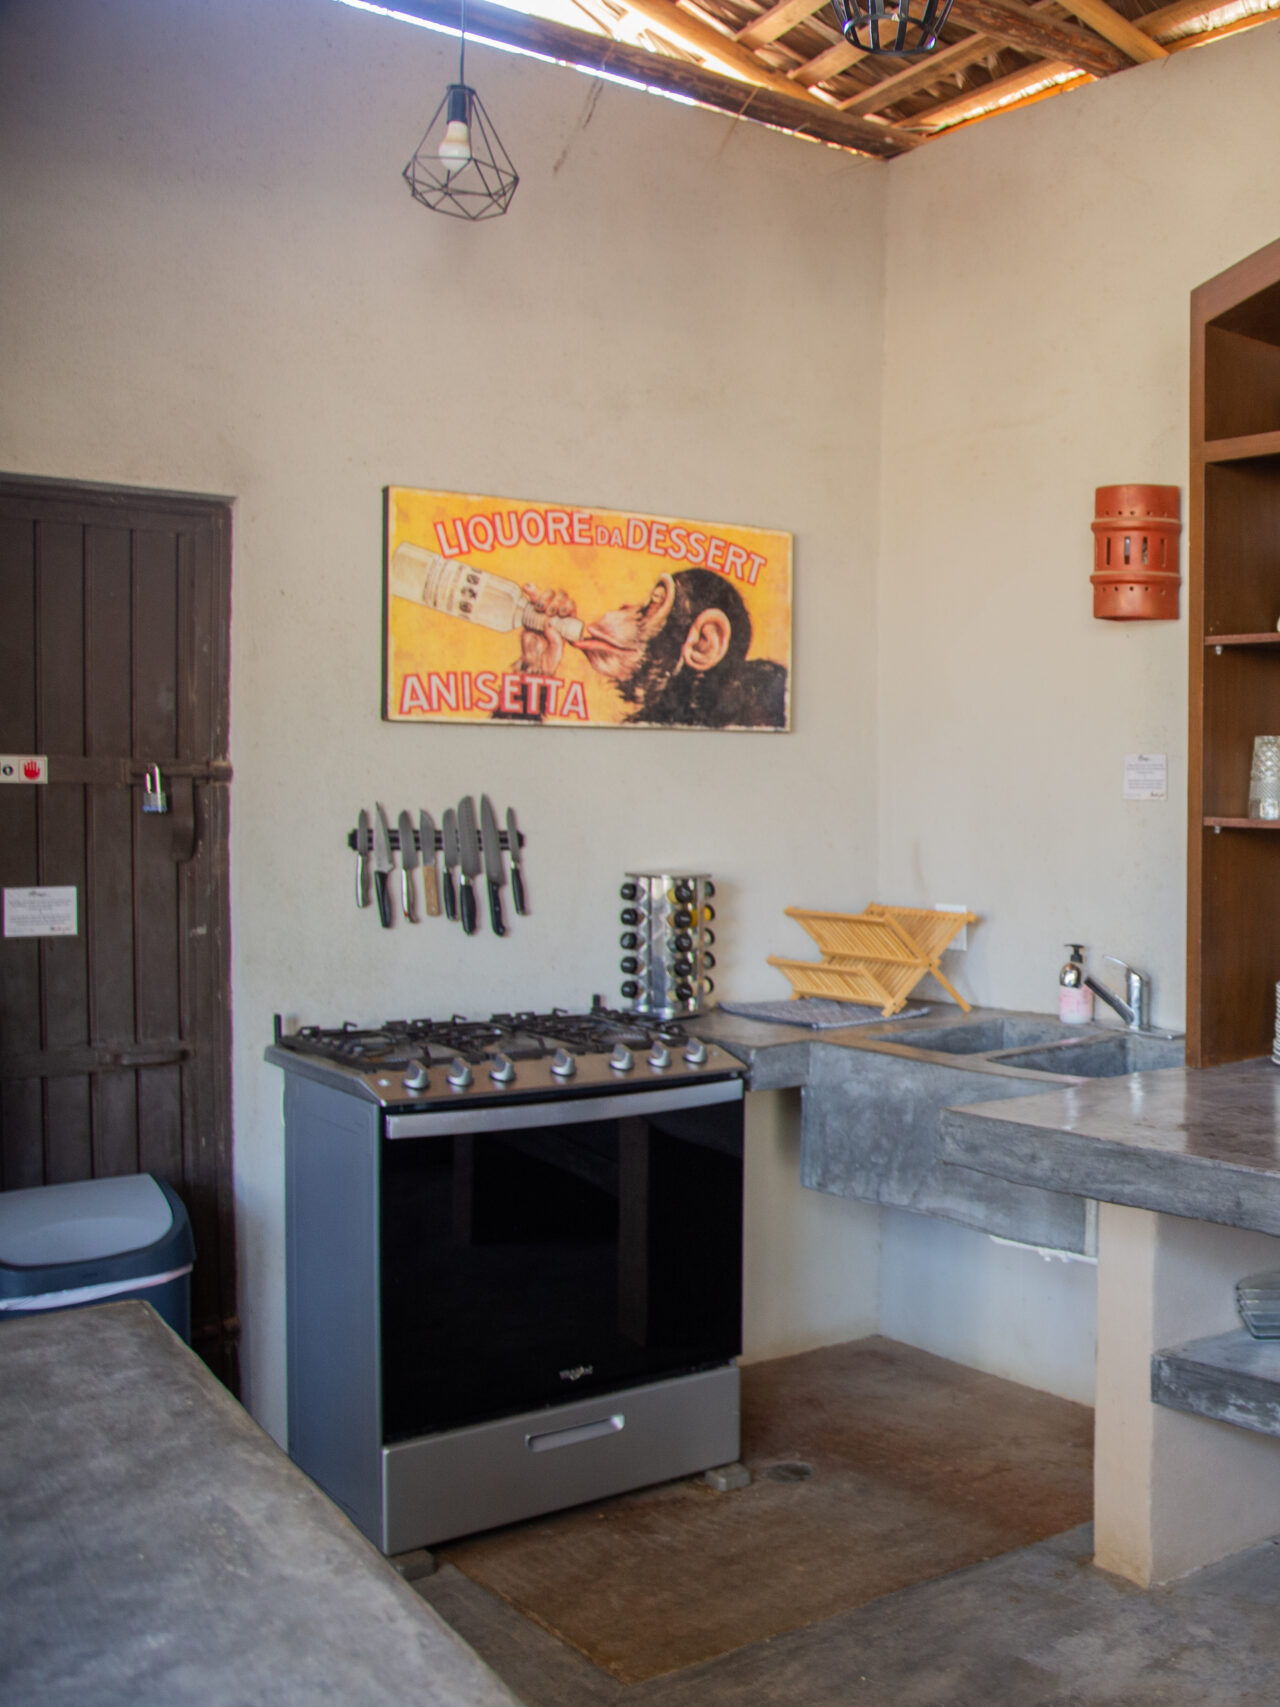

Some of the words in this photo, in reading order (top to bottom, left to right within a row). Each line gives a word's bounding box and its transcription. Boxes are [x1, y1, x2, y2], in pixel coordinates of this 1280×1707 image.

[434, 509, 594, 558] LIQUORE
[595, 526, 624, 548] DA
[626, 517, 767, 586] DESSERT
[400, 671, 589, 721] ANISETTA
